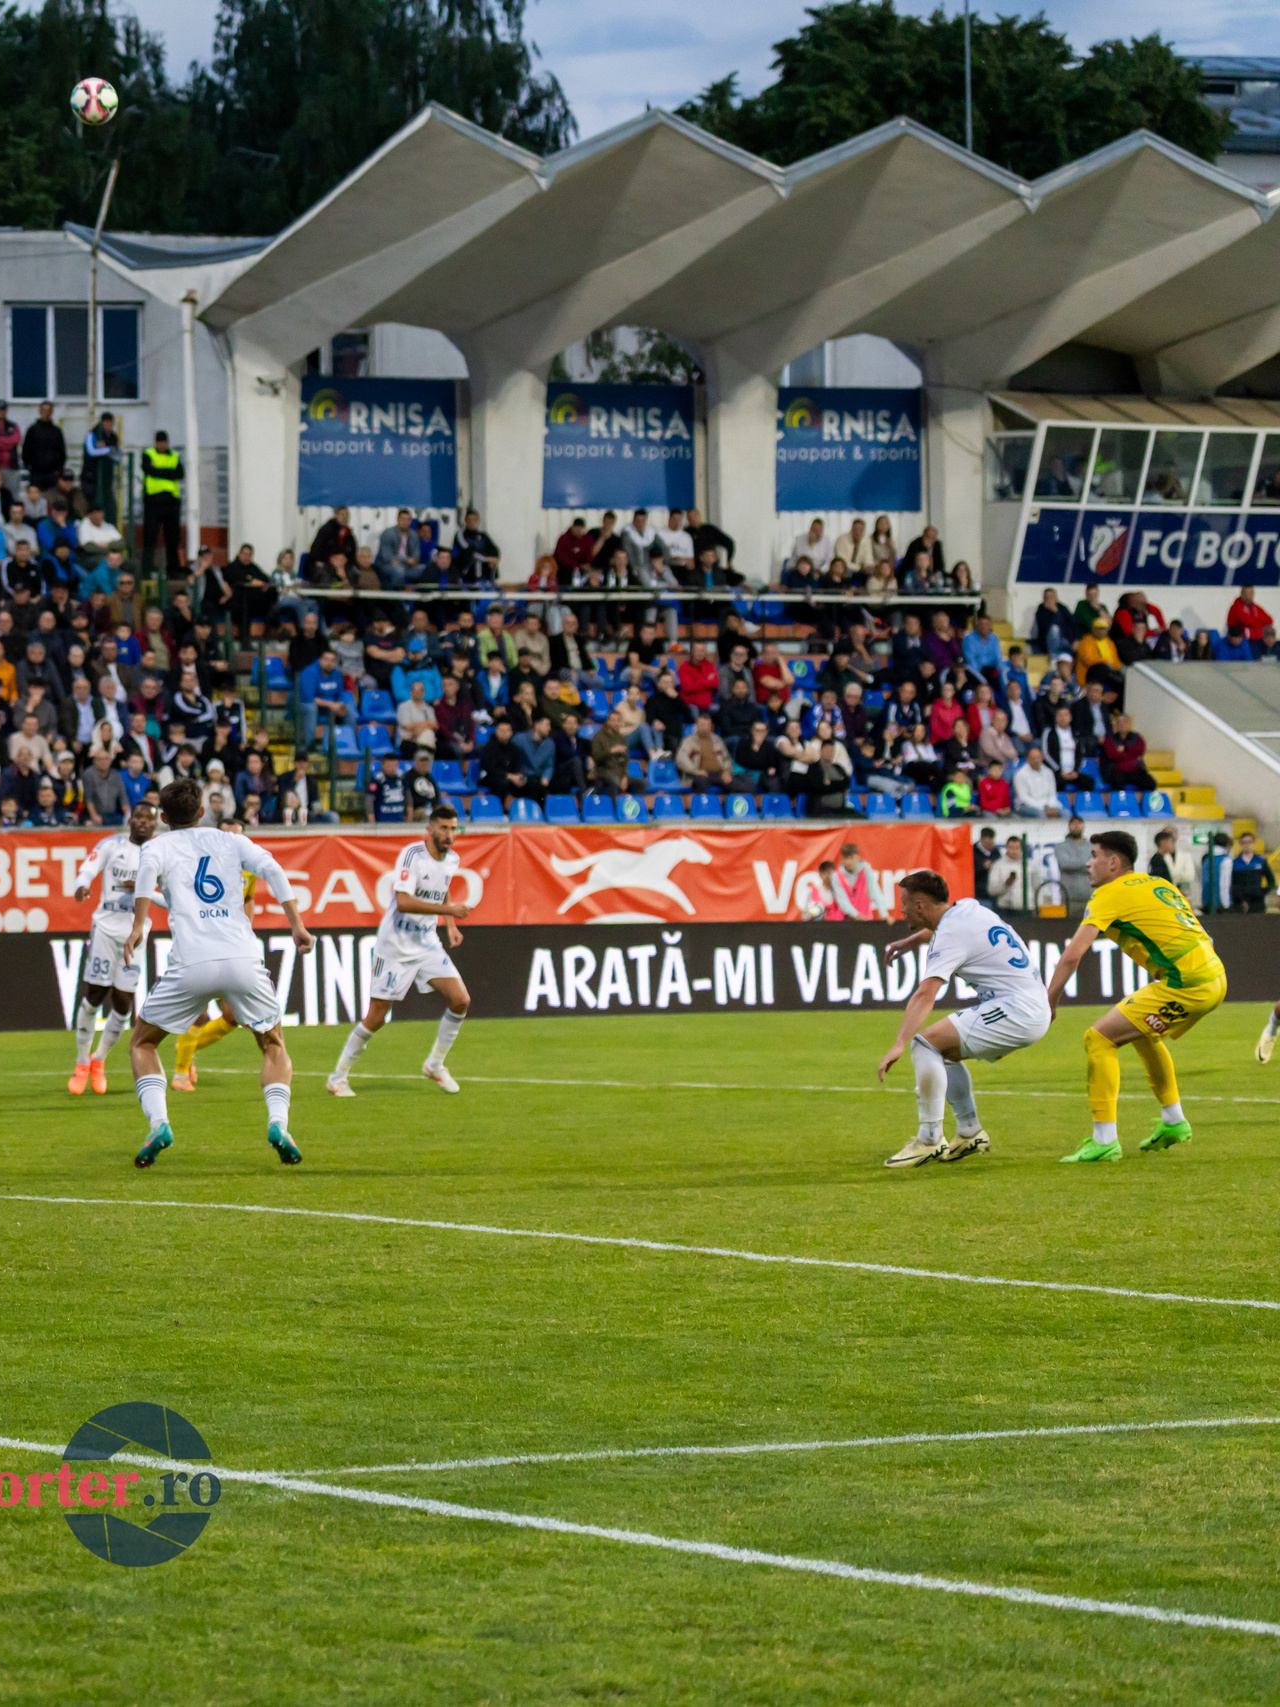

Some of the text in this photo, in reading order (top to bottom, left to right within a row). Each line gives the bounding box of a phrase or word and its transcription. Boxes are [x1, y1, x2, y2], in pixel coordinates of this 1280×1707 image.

[401, 441, 454, 456] sports
[640, 444, 693, 460] sports
[869, 446, 919, 463] sports
[1136, 530, 1187, 568] FC
[194, 855, 225, 904] 6
[200, 909, 229, 919] DICAN
[524, 931, 775, 1011] ARATĂ-MI
